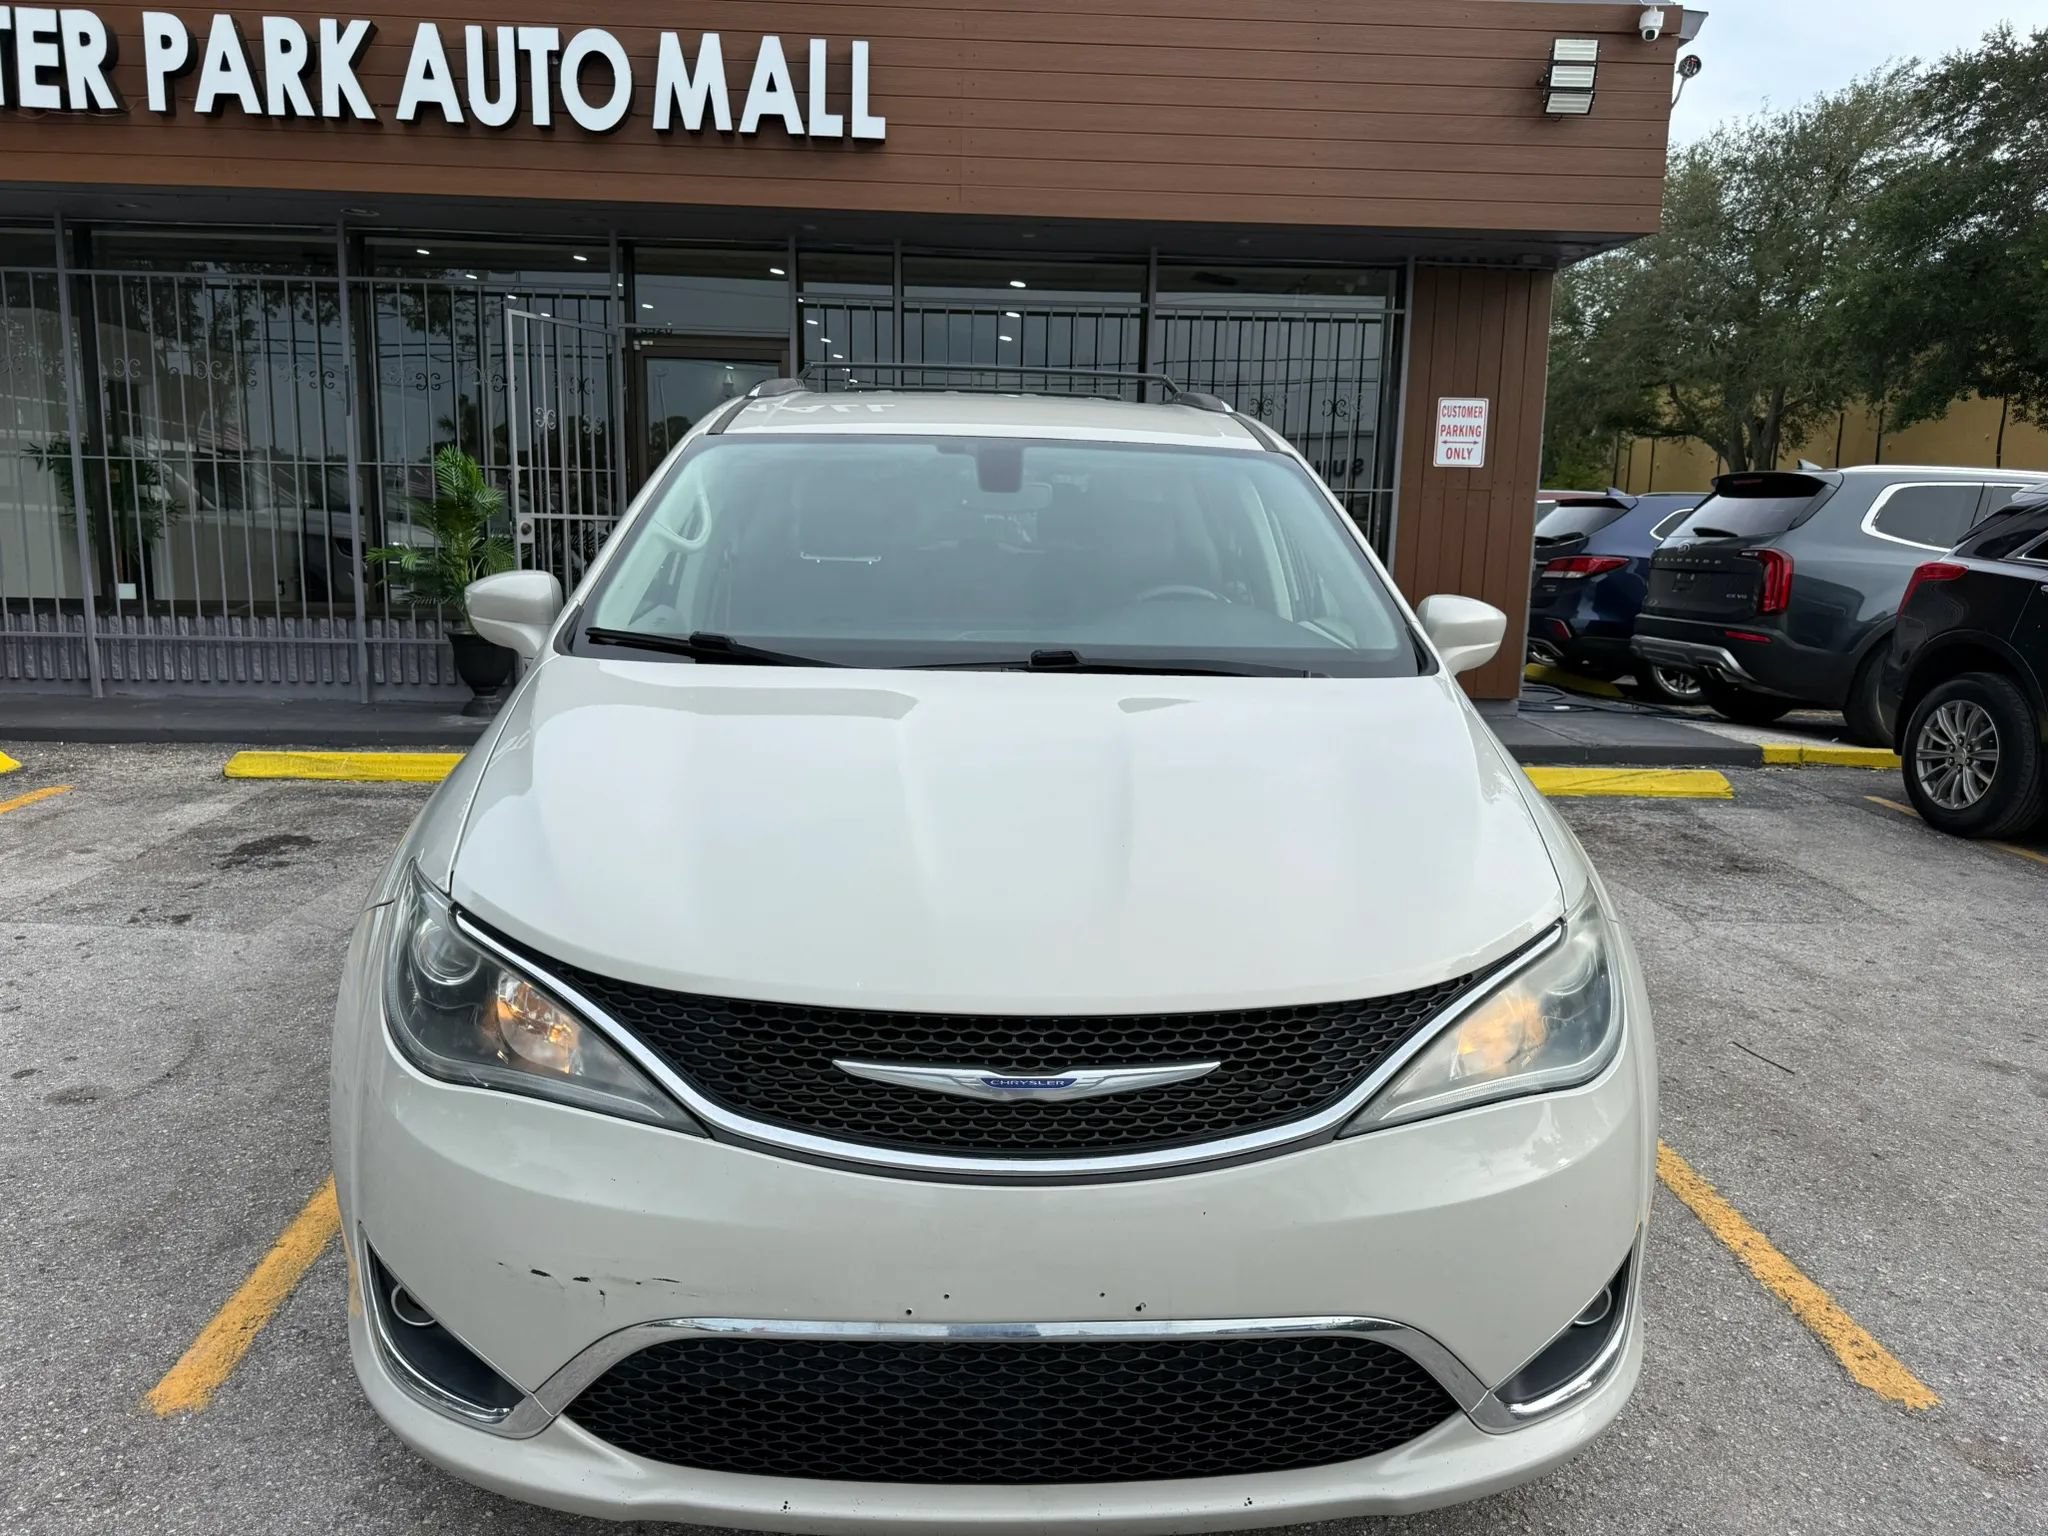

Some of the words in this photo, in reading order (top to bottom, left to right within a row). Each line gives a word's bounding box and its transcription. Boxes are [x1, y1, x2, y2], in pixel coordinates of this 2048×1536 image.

[0, 5, 118, 109] ER
[142, 11, 376, 119] PARK
[396, 22, 632, 131] AUTO
[653, 32, 886, 139] MALL
[1441, 405, 1484, 418] CUSTOMER
[1440, 424, 1482, 437] PARKING
[1445, 447, 1473, 460] ONLY
